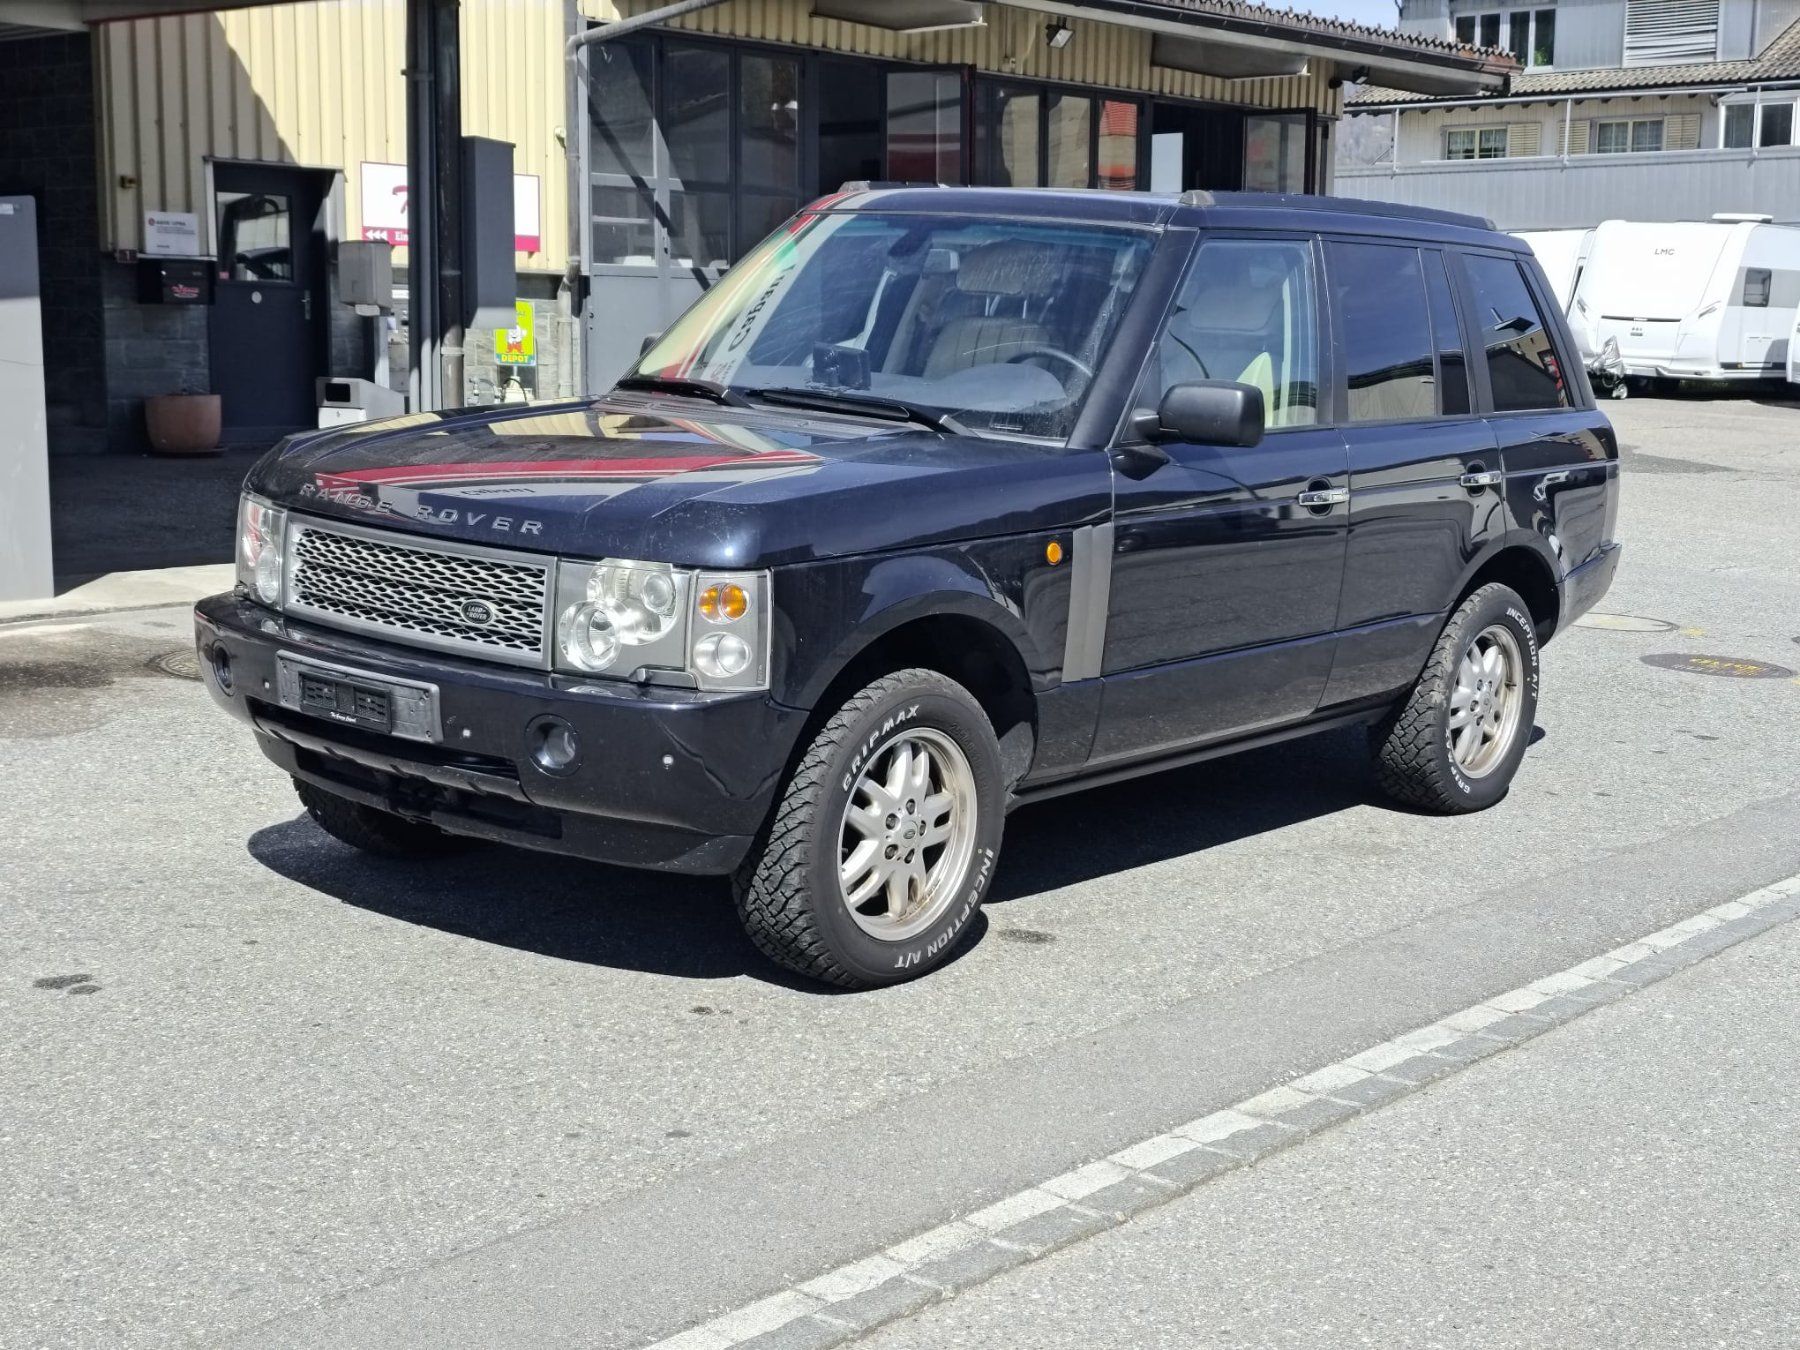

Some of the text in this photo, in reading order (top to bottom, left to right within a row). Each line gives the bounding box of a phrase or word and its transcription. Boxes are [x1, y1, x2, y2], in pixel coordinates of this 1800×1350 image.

[1653, 247, 1676, 256] LMC
[501, 354, 529, 363] DEPOT
[299, 482, 544, 535] RANGE ROVER
[1506, 607, 1540, 700] INCEPTION A/T
[842, 705, 920, 792] GRIPMAX
[927, 848, 994, 958] INCEPTION
[894, 949, 922, 969] A/T
